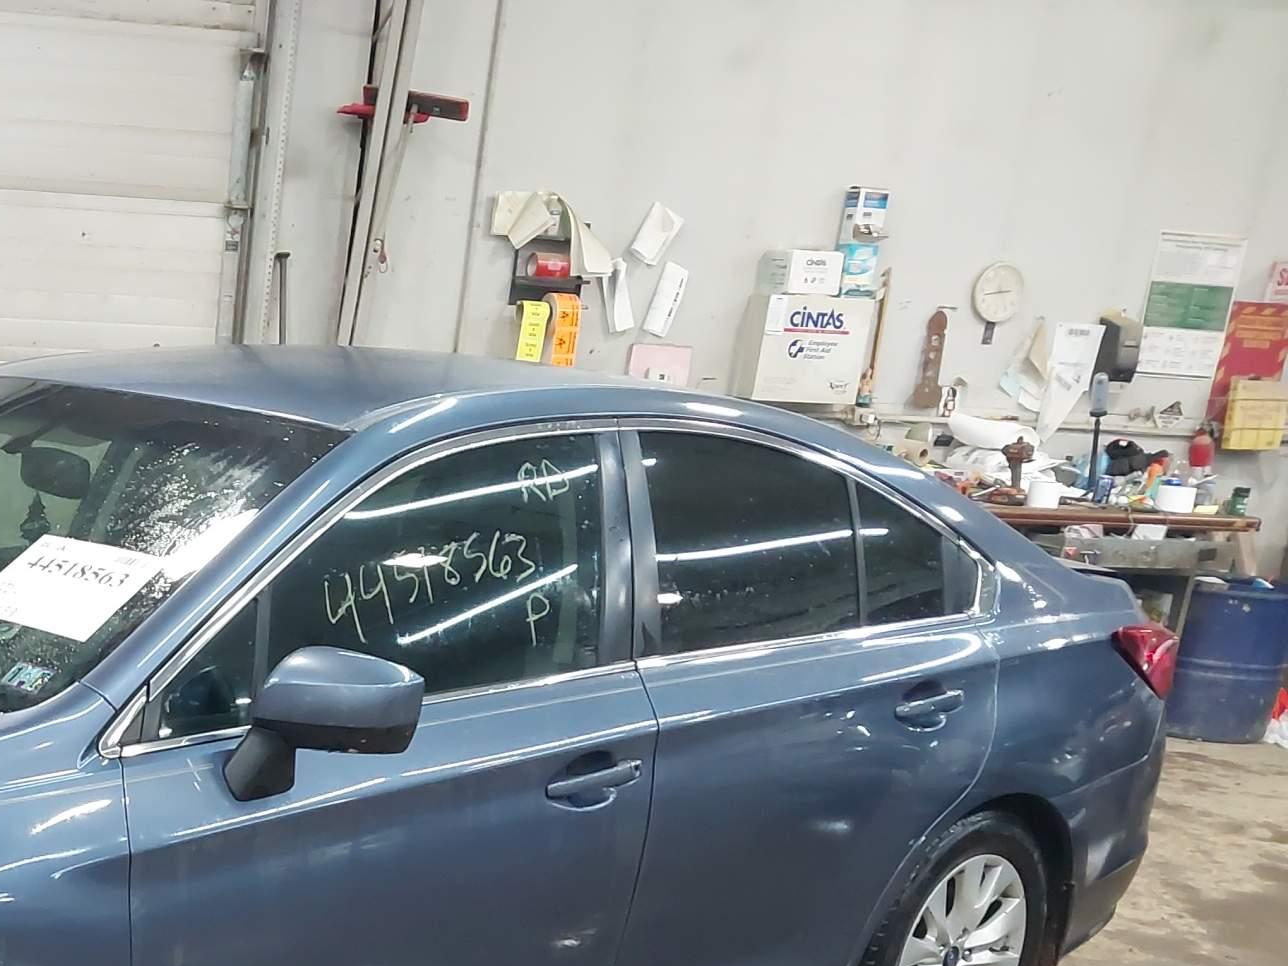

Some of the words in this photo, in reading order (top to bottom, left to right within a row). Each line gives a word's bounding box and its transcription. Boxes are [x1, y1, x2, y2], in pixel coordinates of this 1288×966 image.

[789, 306, 844, 329] CINTAS
[27, 556, 130, 587] 44518563
[323, 530, 535, 643] 44518563
[526, 593, 550, 646] P
